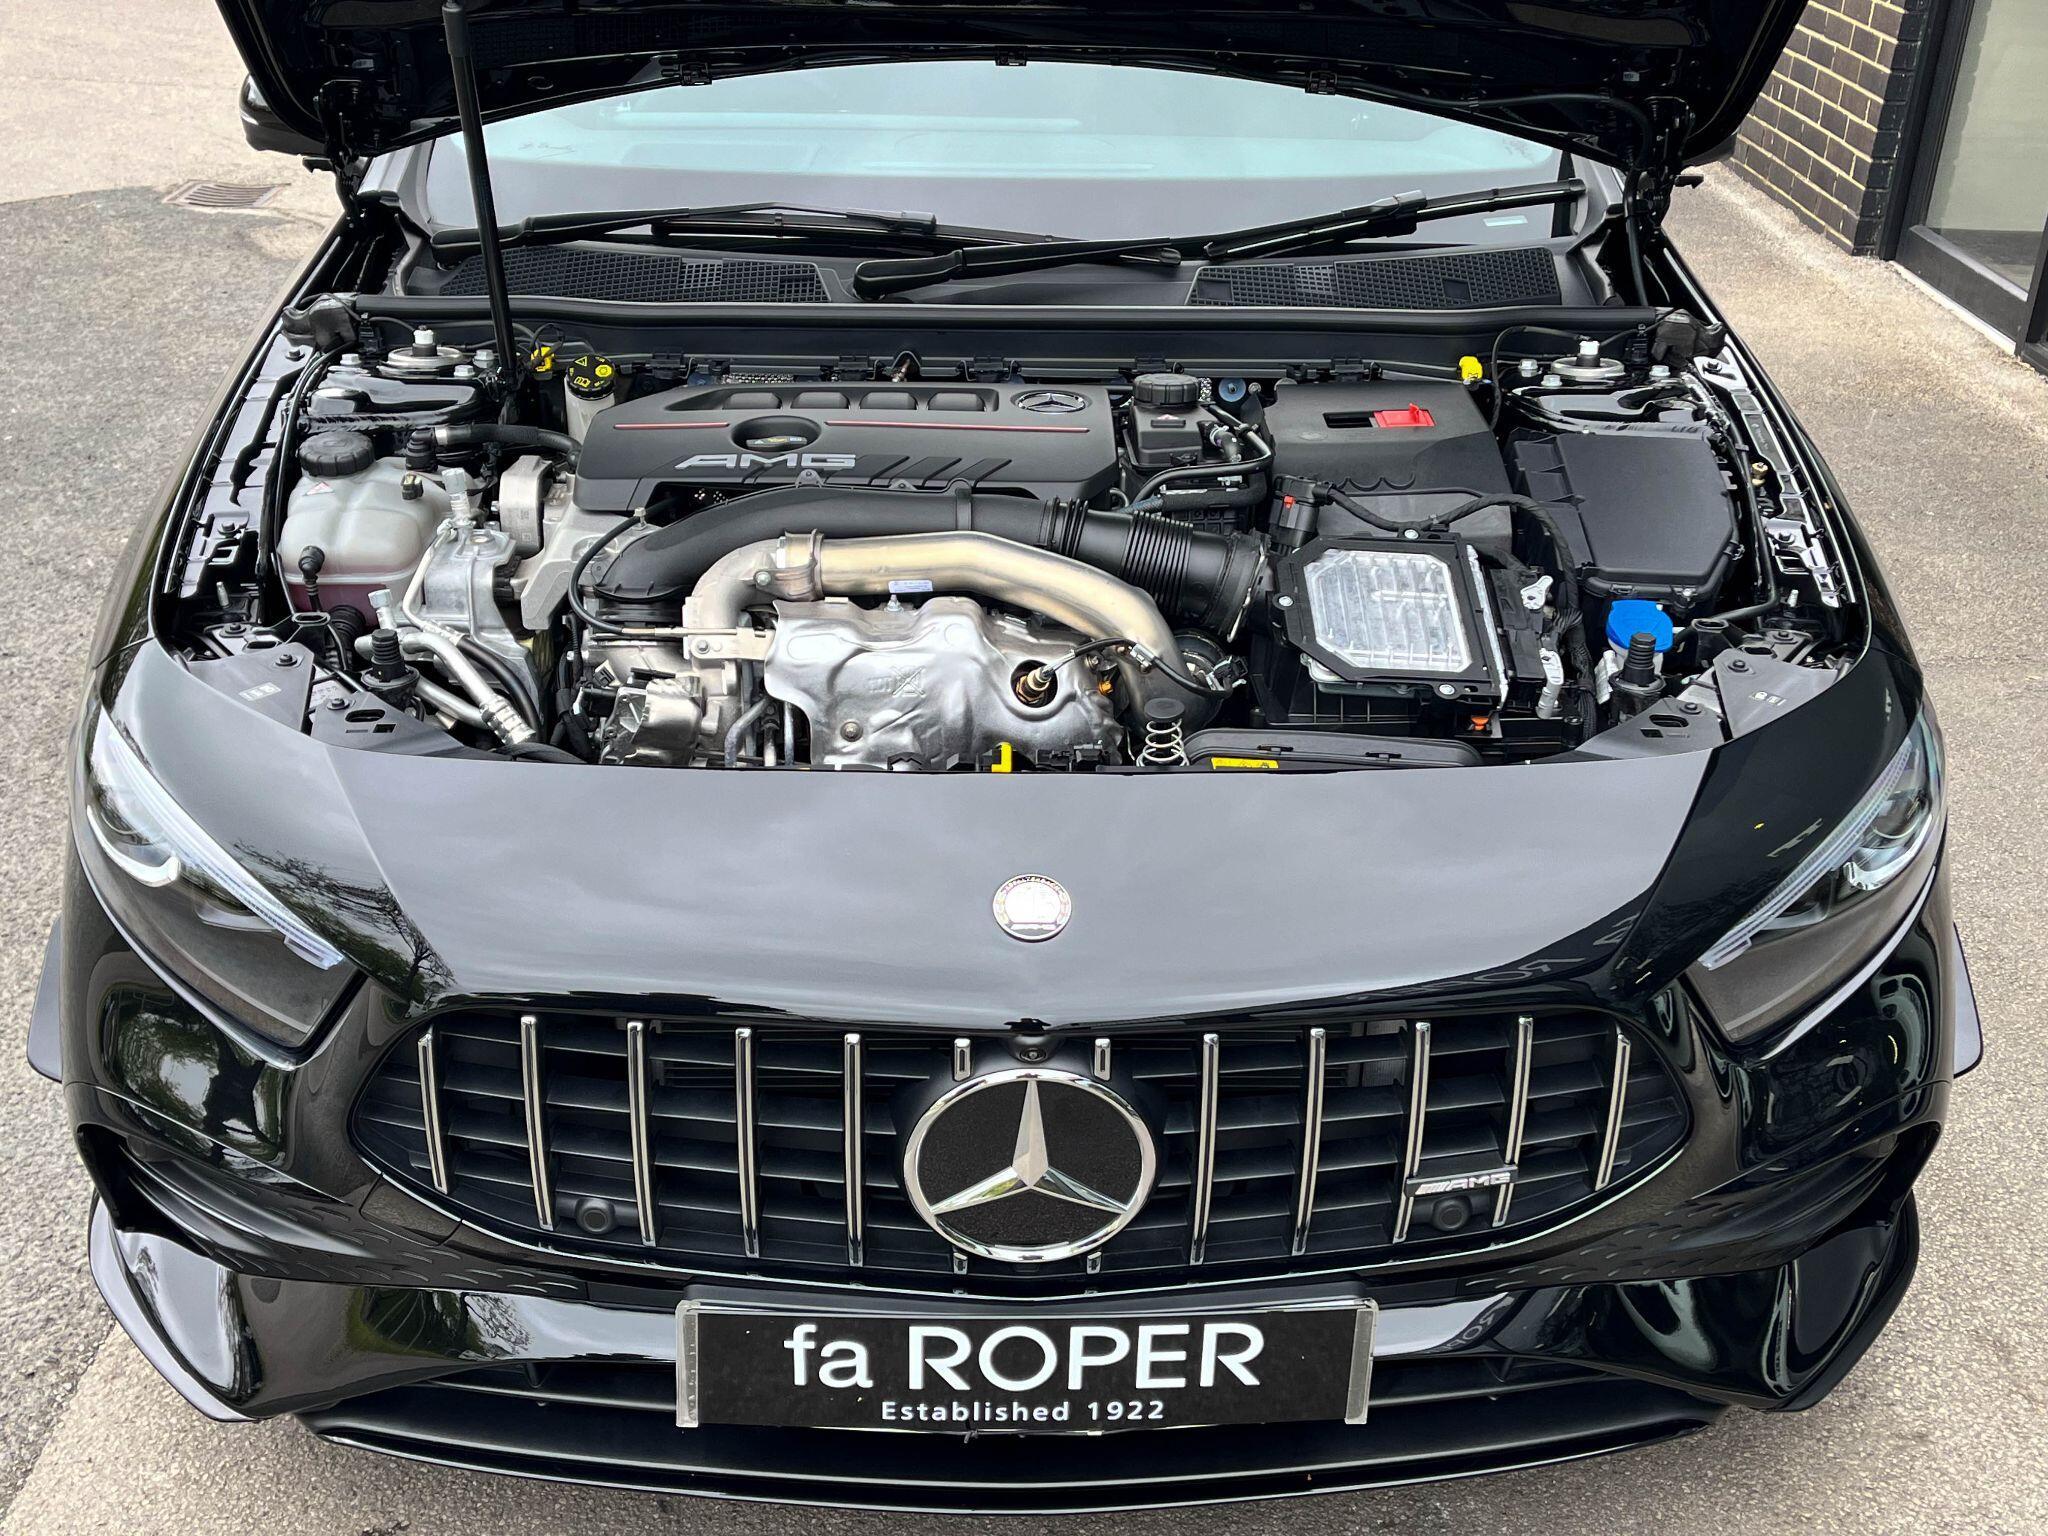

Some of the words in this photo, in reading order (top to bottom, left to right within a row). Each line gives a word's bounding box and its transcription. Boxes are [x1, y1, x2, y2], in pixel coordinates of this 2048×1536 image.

[674, 453, 857, 471] AMG
[783, 1324, 874, 1388] fa
[908, 1323, 1265, 1392] ROPER
[881, 1400, 1070, 1422] Established
[1087, 1400, 1165, 1421] 1922
